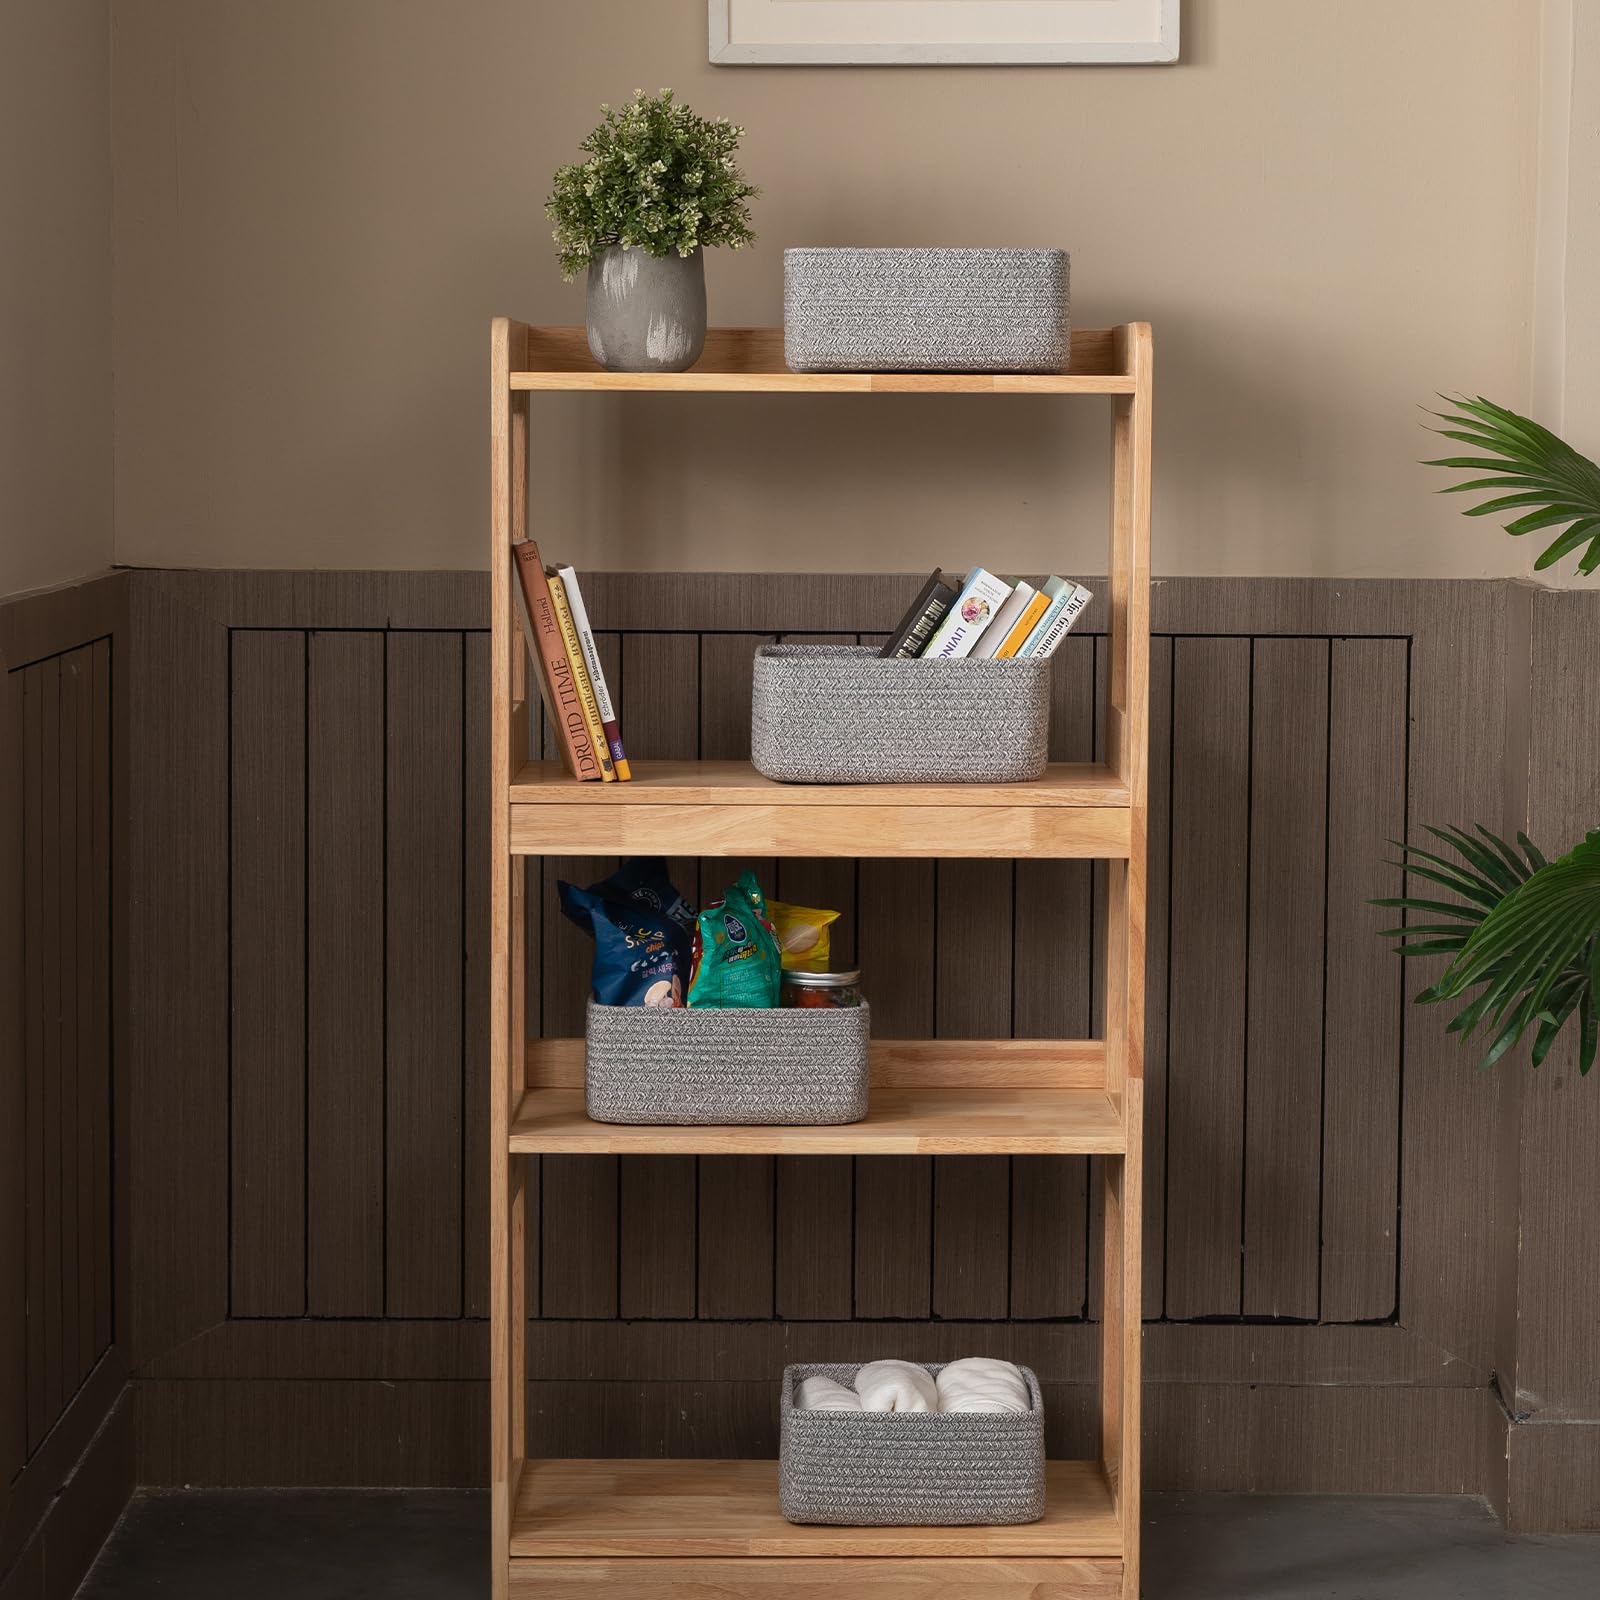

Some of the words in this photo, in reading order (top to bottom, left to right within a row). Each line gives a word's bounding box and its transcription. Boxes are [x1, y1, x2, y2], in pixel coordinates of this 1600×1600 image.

[536, 597, 556, 634] Holland
[926, 598, 946, 619] TAKE
[1065, 595, 1085, 616] The
[903, 634, 921, 652] THE
[912, 616, 934, 637] BACK
[1036, 617, 1070, 658] Grimoire
[560, 606, 580, 657] РУССКАЯ
[575, 663, 600, 727] ТВЕРДЫНЯ
[582, 631, 601, 681] Selbstmanagement
[552, 657, 578, 710] TIME
[596, 685, 611, 717] Schröder
[566, 711, 596, 773] DRUID
